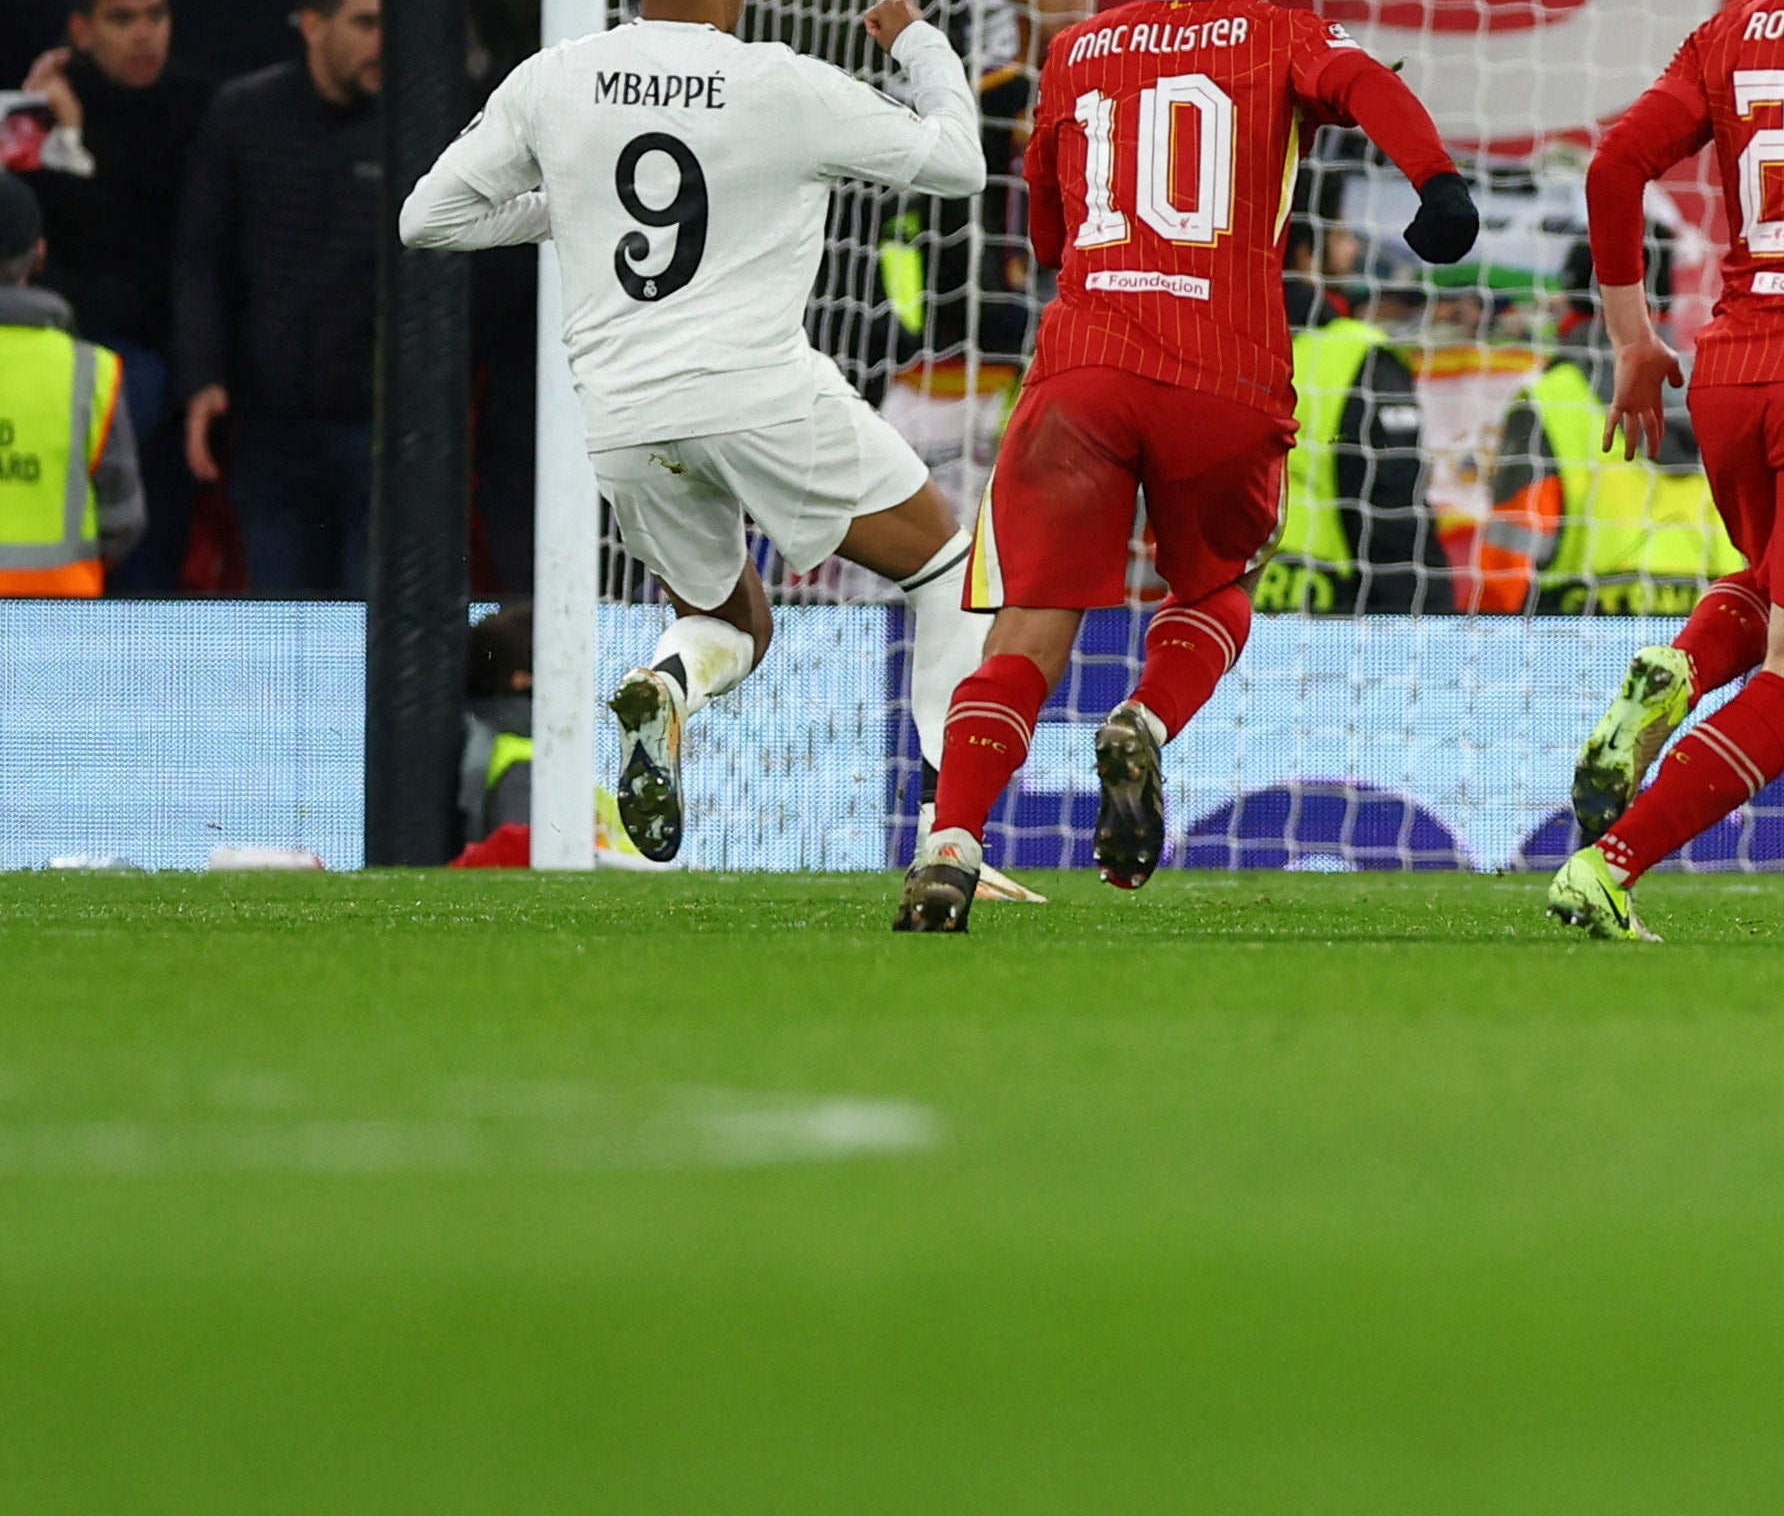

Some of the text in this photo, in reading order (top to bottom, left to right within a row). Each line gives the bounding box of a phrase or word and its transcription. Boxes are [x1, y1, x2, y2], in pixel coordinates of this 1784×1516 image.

[1067, 16, 1249, 67] MAC ALLISTER
[594, 70, 727, 109] MBAPPÉ
[1073, 73, 1238, 249] 10
[613, 131, 709, 302] 9
[1108, 274, 1204, 297] Foundation
